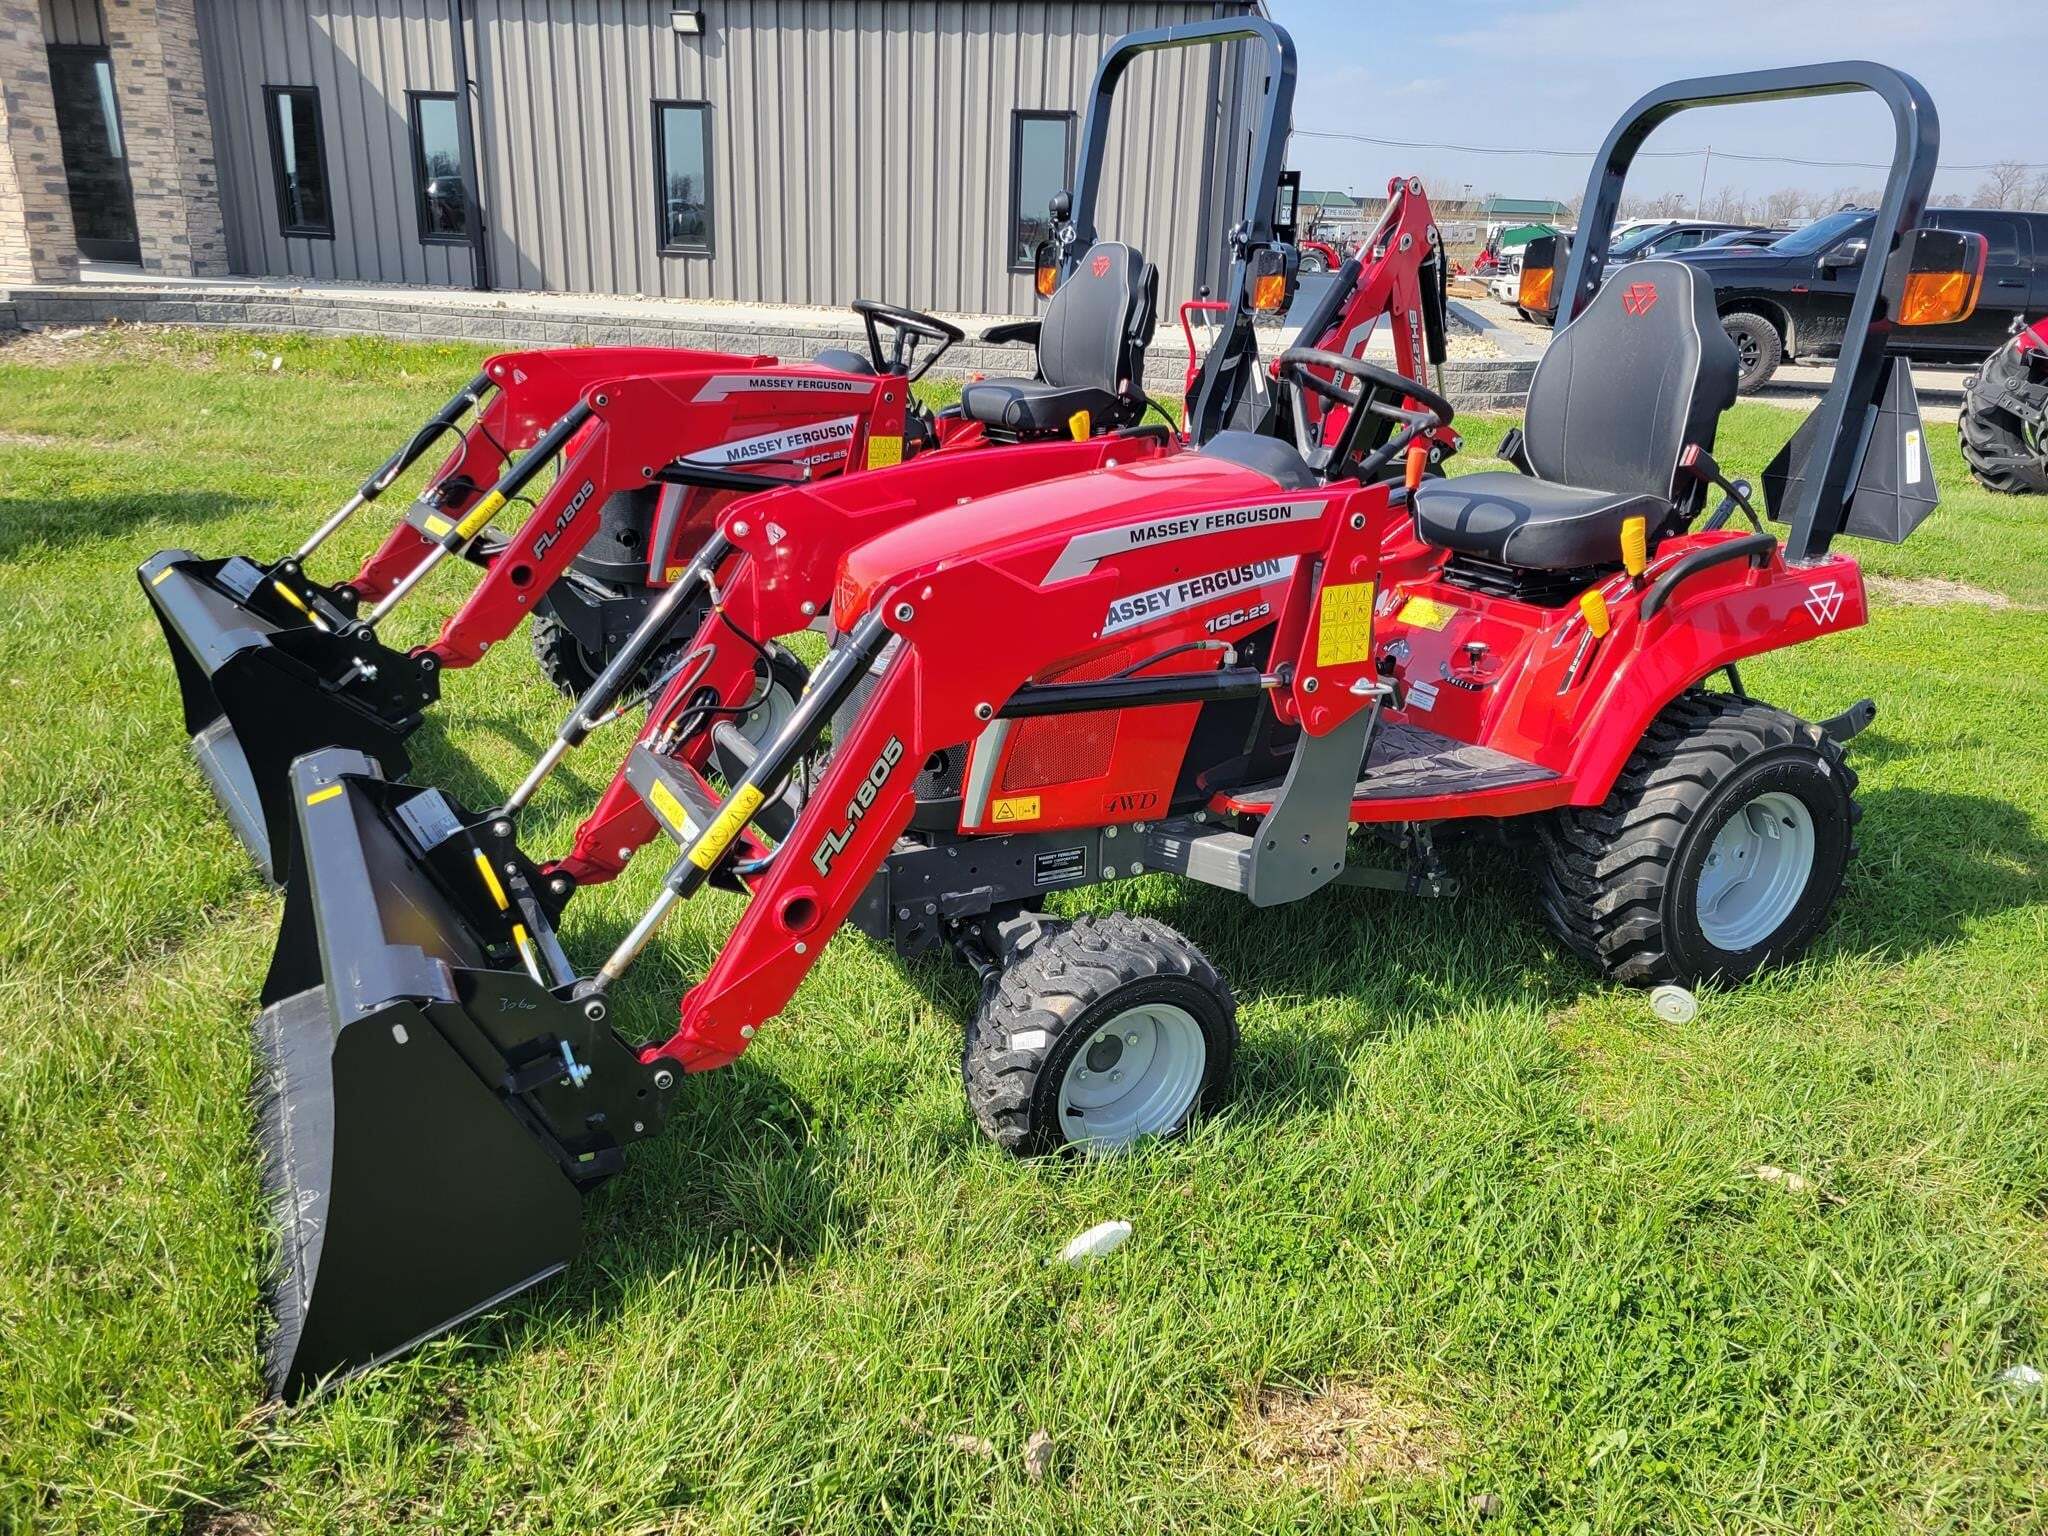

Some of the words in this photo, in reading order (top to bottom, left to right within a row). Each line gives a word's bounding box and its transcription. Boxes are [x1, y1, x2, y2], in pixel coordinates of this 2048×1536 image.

[749, 379, 794, 389] MASSEY
[797, 380, 852, 391] FERGUSON
[726, 438, 782, 462] MASSEY
[786, 423, 854, 447] FERGUSON
[532, 480, 594, 561] FL.1805
[1130, 518, 1199, 544] MASSEY
[1205, 505, 1292, 530] FERGUSON
[1105, 588, 1172, 627] ASSEY
[1178, 559, 1281, 603] FERGUSON
[1204, 602, 1271, 633] 1GC.23
[811, 735, 904, 877] FL.1805
[1104, 792, 1158, 813] 4WD
